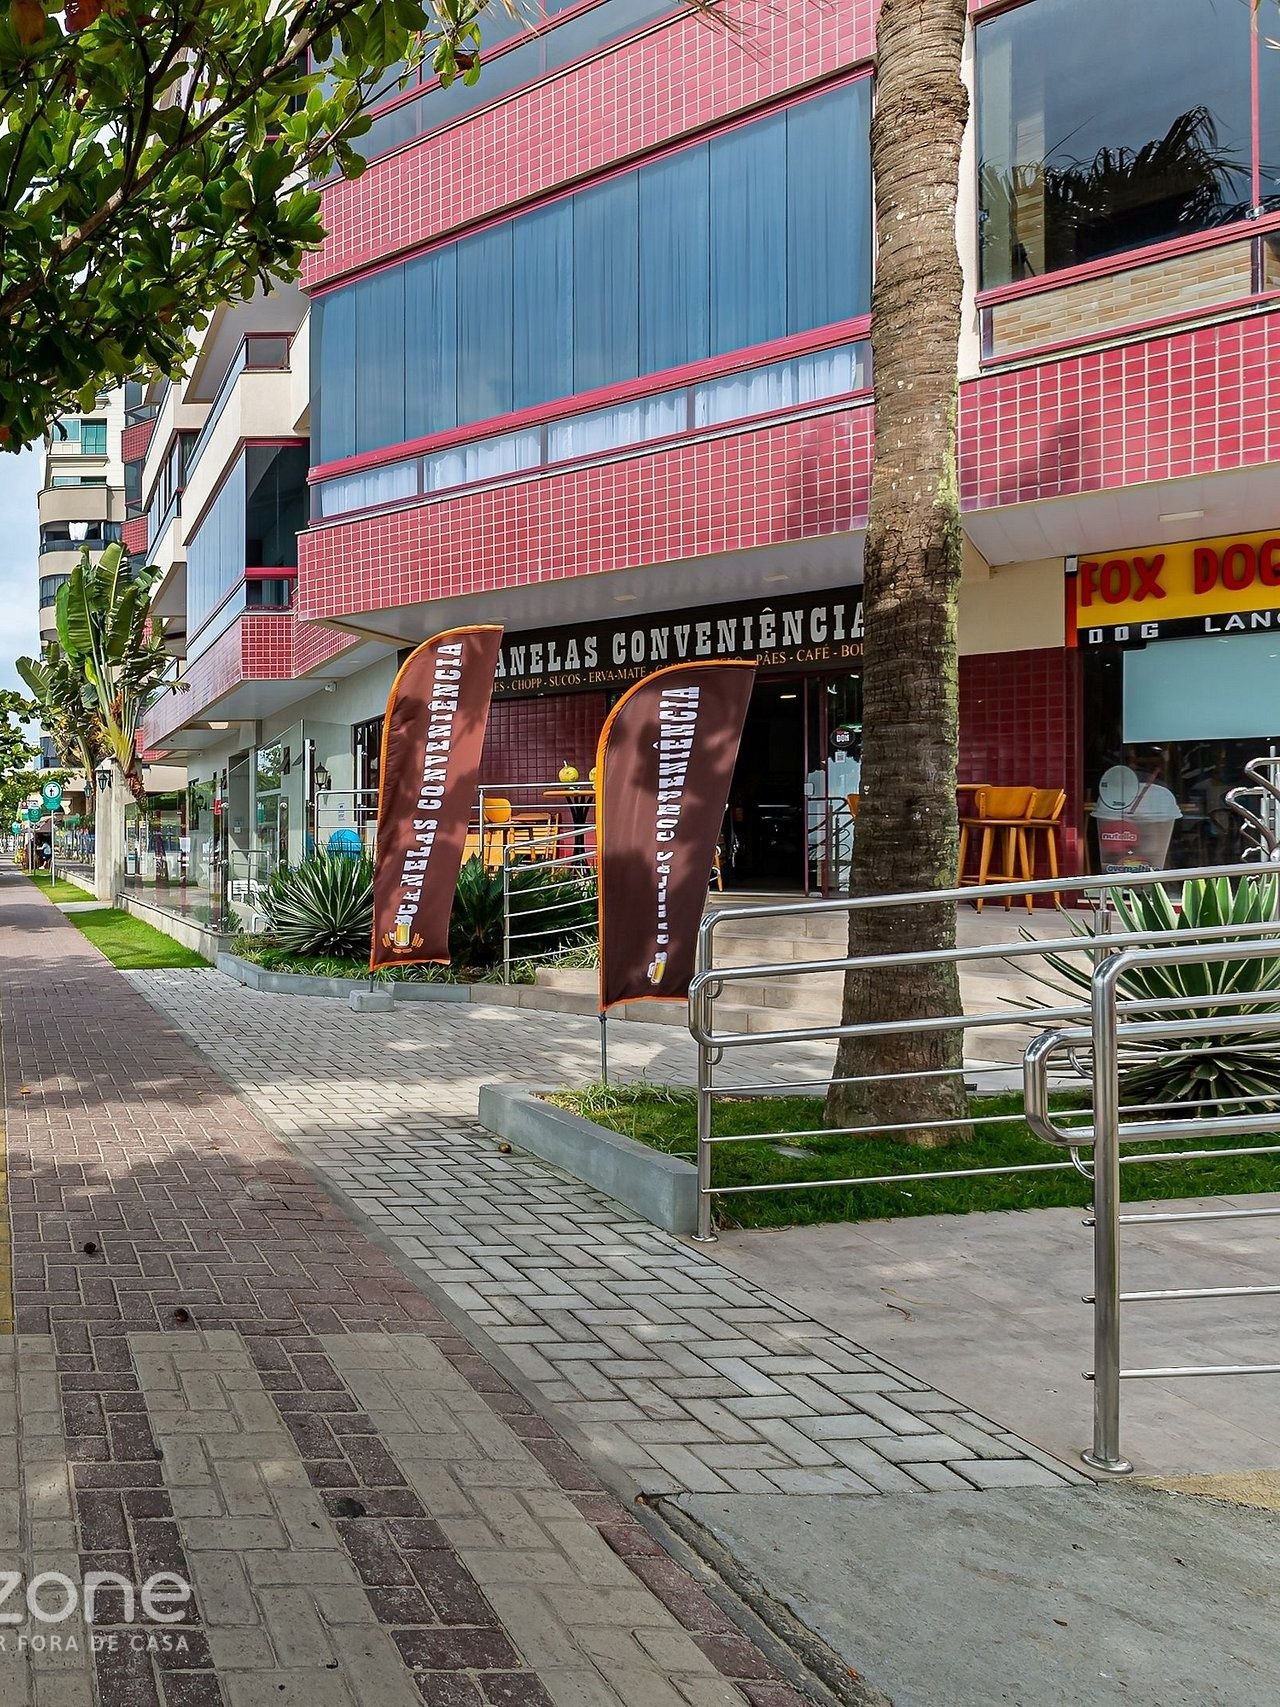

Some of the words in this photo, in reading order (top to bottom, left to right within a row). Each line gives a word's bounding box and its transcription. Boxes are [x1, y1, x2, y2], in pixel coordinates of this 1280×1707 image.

[1081, 553, 1167, 607] FOX
[493, 636, 598, 677] ANELAS
[612, 602, 865, 664] CONVENIÊNCIA
[1088, 623, 1159, 644] DOG
[1204, 611, 1280, 632] LAN
[511, 677, 542, 691] CHOPP
[549, 672, 581, 687] SUCOS
[589, 666, 647, 683] ERVA-MATE
[796, 643, 830, 662] CAFÉ
[416, 642, 464, 810] CONVENIÊNCIA
[652, 686, 700, 842] CONVENIÊNCIA
[397, 819, 438, 915] CANELAS
